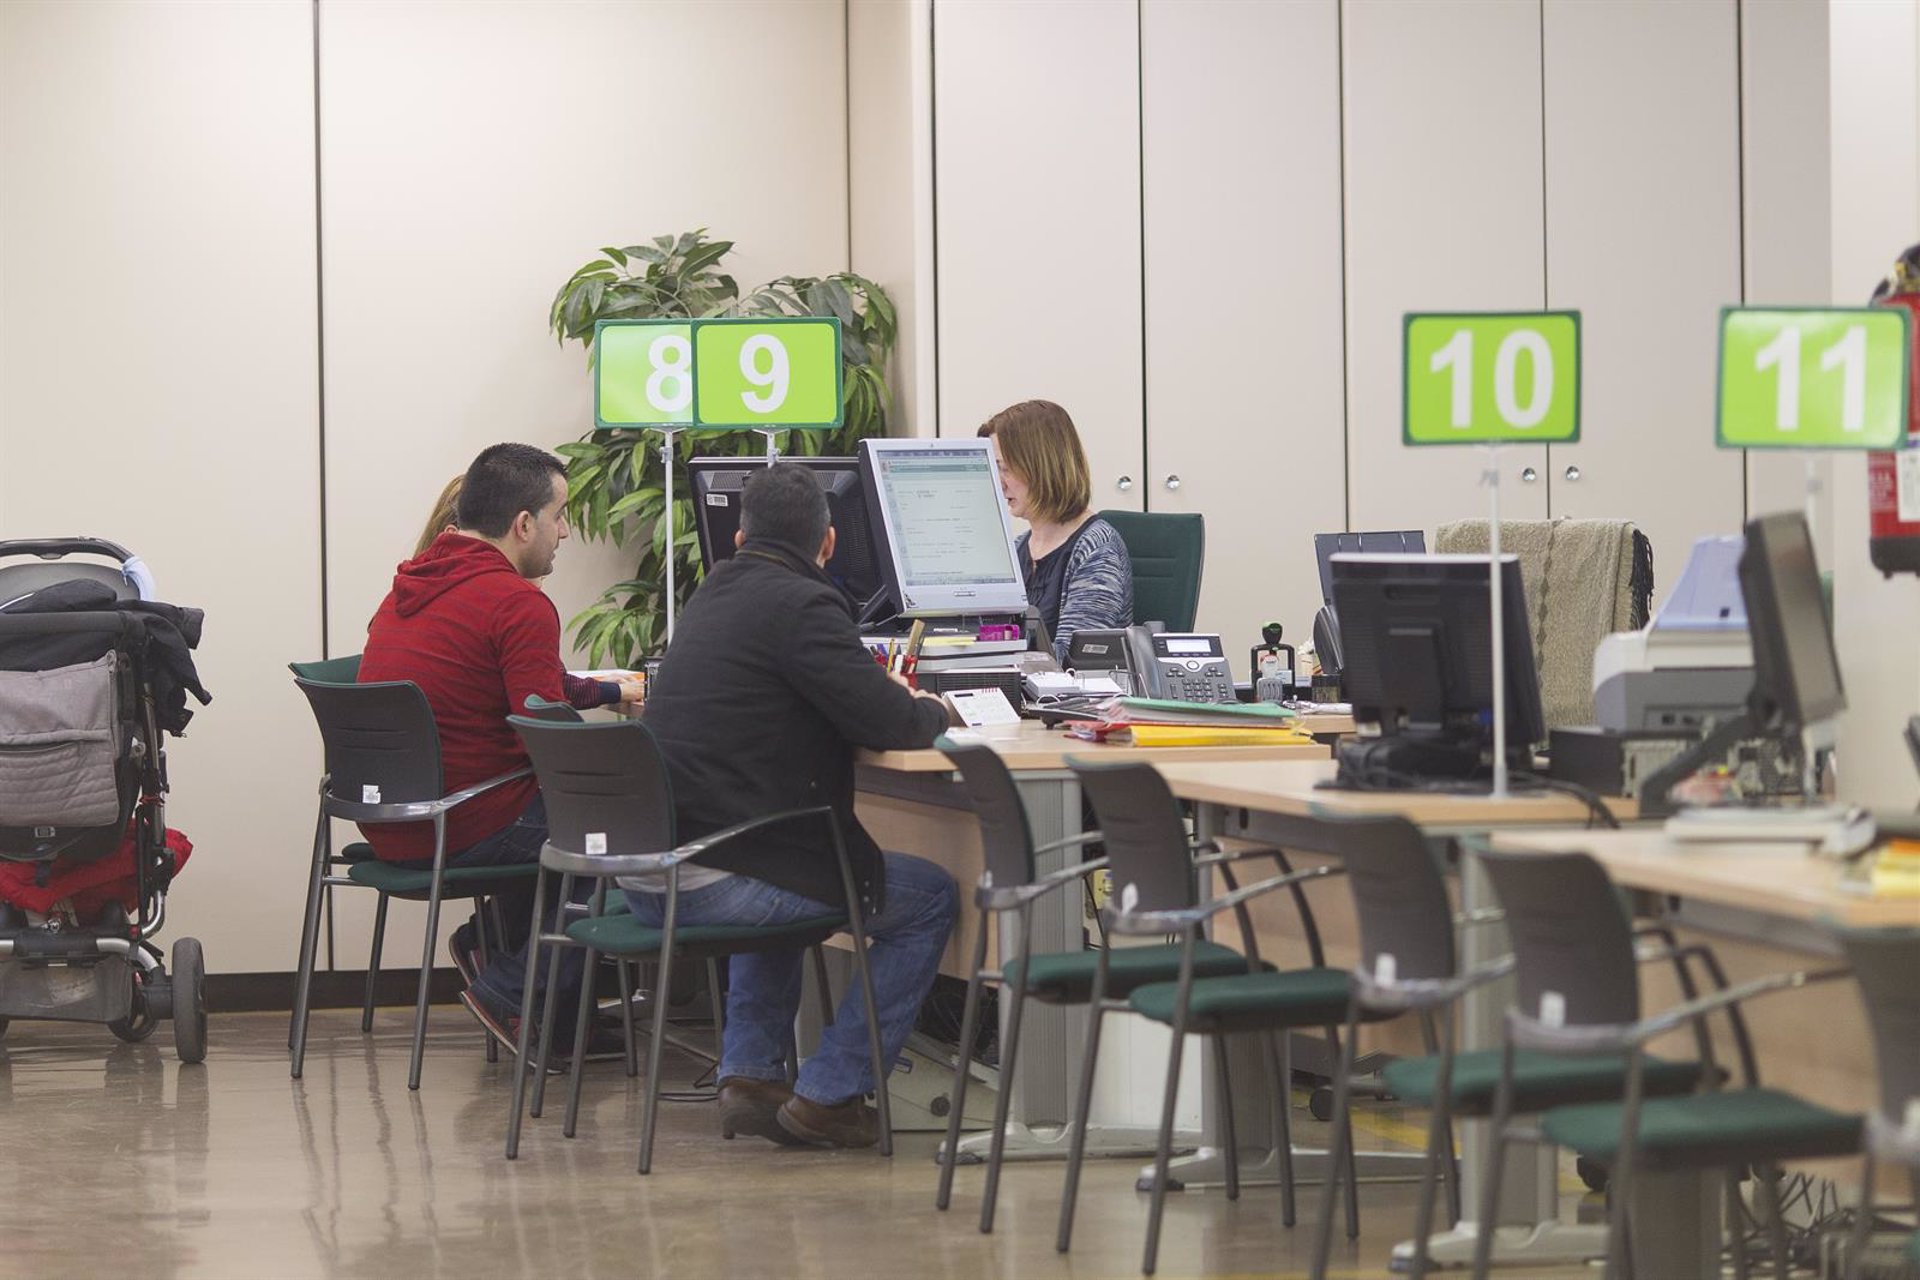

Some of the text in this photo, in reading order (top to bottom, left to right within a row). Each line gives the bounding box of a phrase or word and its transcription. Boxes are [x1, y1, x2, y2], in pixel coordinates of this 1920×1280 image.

[646, 335, 691, 412] 8
[739, 334, 790, 413] 9
[1430, 329, 1554, 429] 10
[1755, 325, 1867, 431] 11
